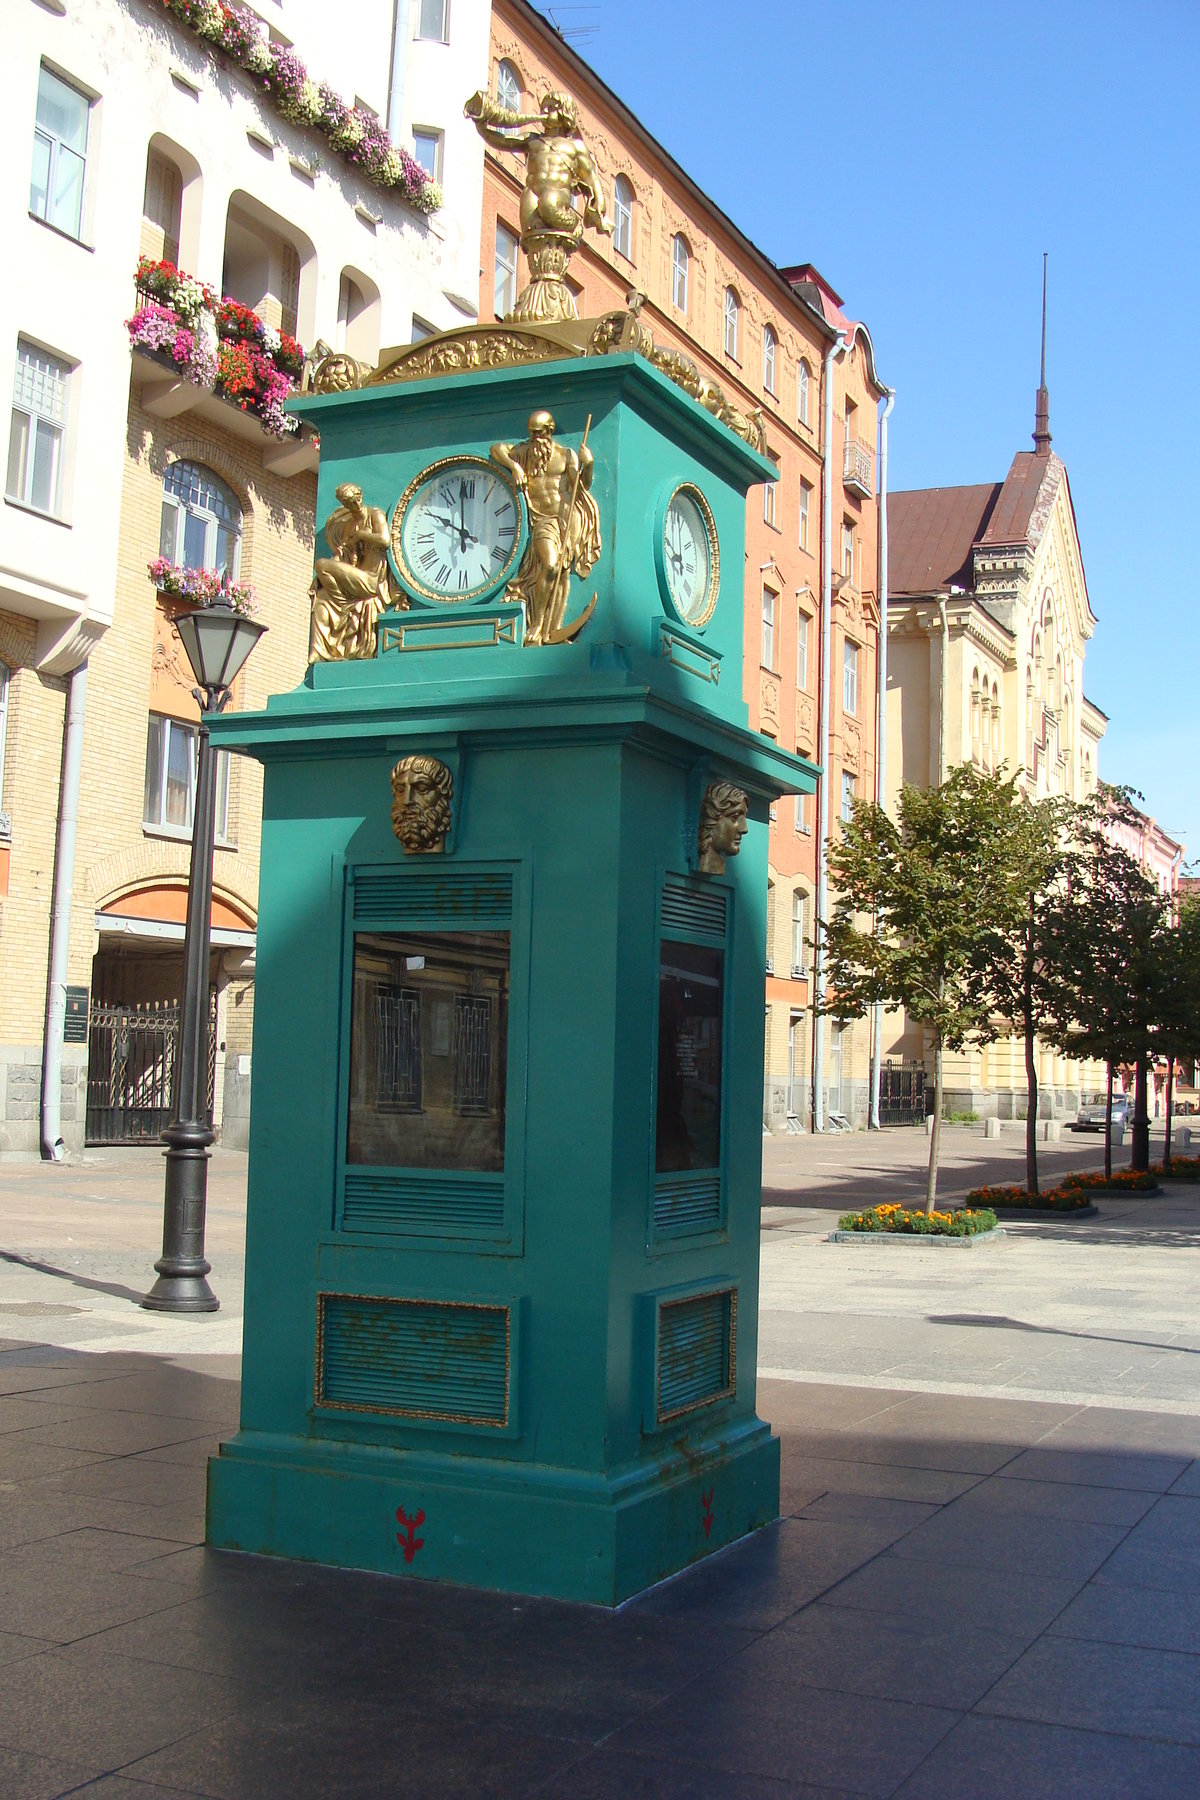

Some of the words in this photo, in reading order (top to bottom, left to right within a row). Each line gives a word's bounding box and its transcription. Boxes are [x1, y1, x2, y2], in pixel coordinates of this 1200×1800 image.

[440, 488, 456, 509] XI
[484, 485, 494, 503] I
[494, 502, 512, 517] II
[417, 532, 434, 544] IX
[498, 527, 516, 537] III
[420, 548, 439, 571] VIII
[490, 545, 508, 562] IIII
[434, 564, 452, 586] VII
[458, 570, 469, 590] VI
[480, 563, 490, 581] V
